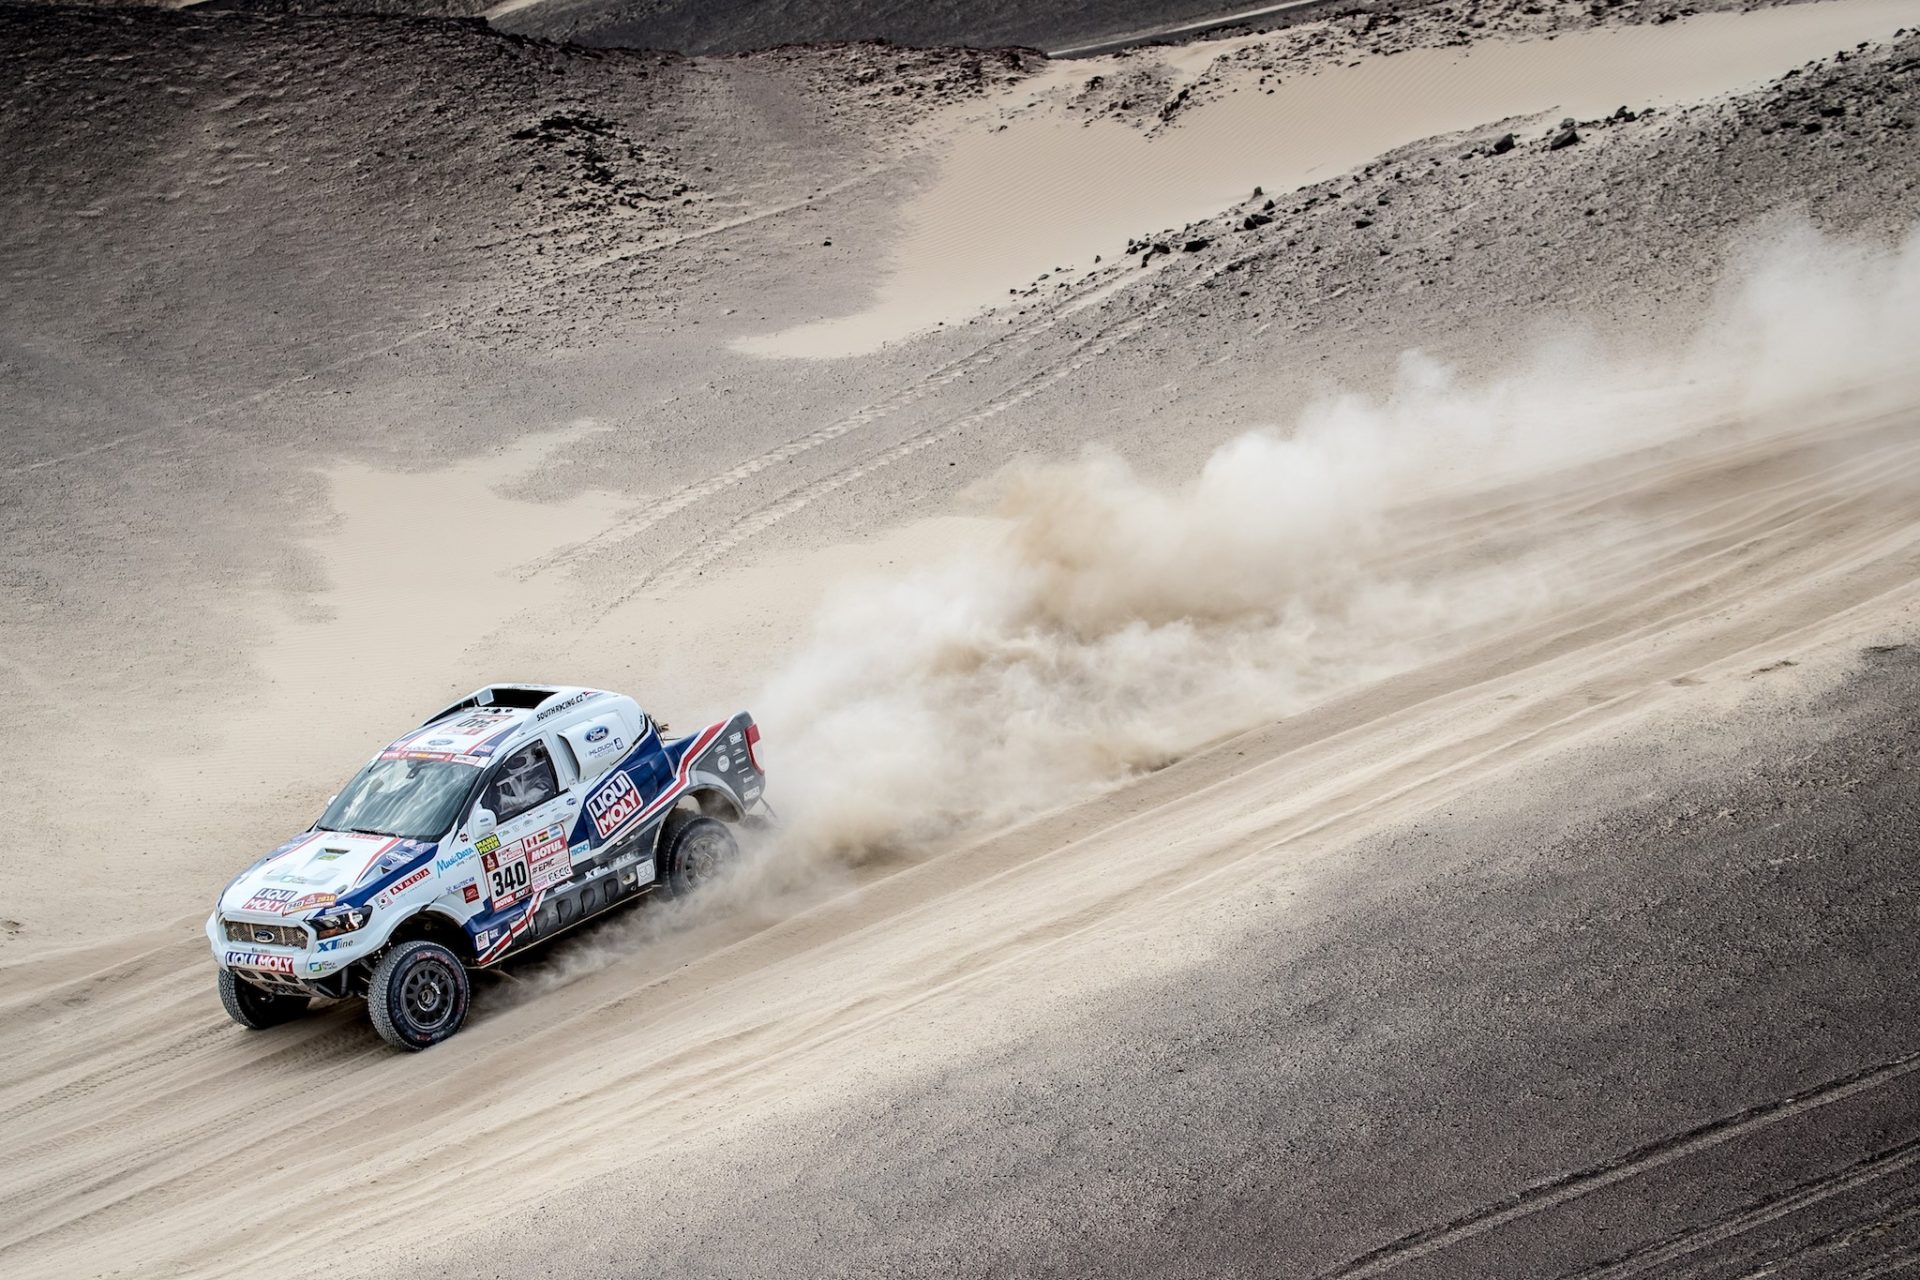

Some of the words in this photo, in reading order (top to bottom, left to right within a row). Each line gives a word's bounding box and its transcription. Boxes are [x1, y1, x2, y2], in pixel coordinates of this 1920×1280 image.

[587, 726, 608, 742] Ford
[590, 774, 631, 817] LIQUI
[598, 789, 638, 833] MOLY
[476, 836, 497, 848] MANN
[480, 841, 500, 855] FILTER
[531, 840, 563, 862] MOTUL
[492, 861, 527, 897] 340
[257, 888, 295, 902] LIQUI
[244, 900, 284, 912] MOLY
[226, 952, 258, 966] LIQUI
[257, 955, 293, 973] MOLY
